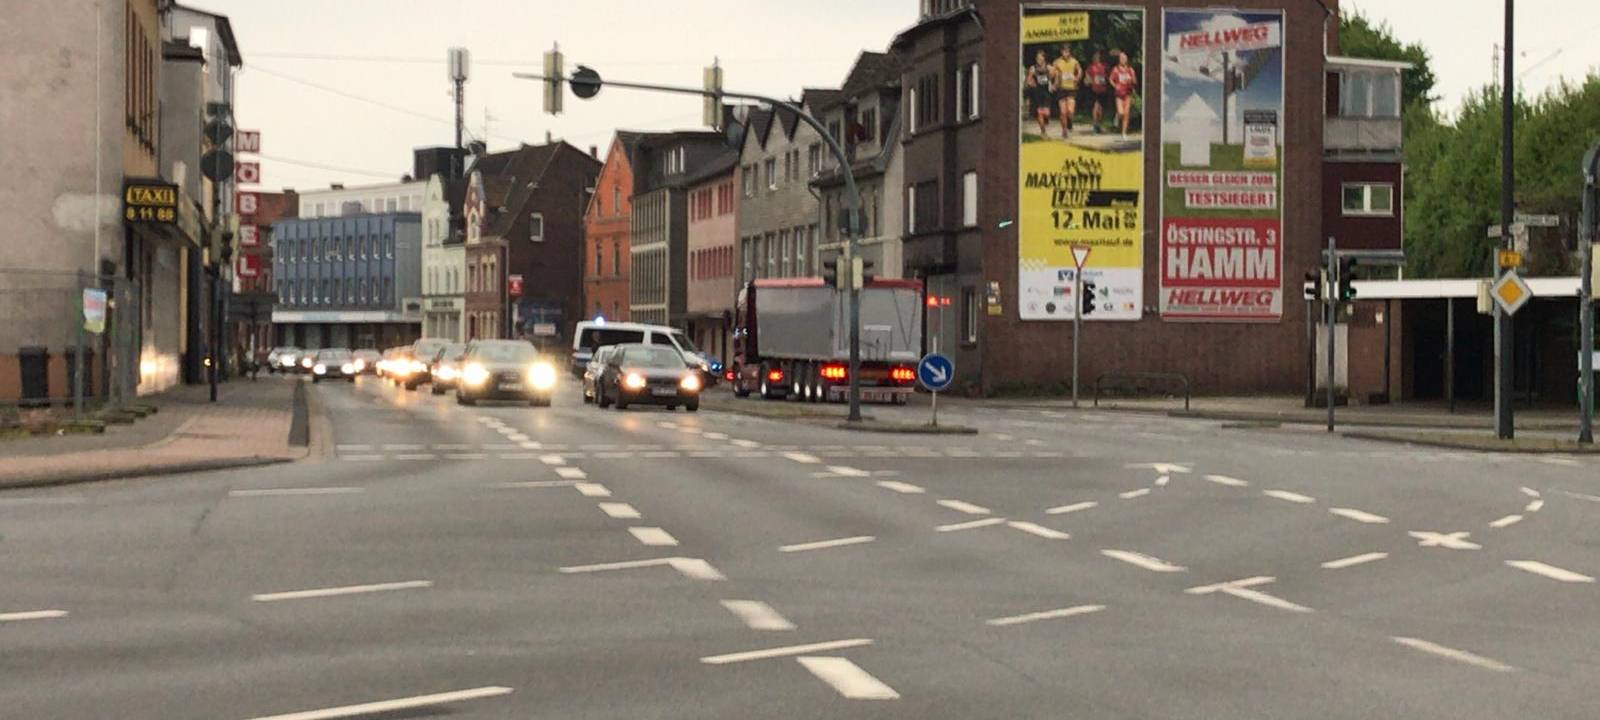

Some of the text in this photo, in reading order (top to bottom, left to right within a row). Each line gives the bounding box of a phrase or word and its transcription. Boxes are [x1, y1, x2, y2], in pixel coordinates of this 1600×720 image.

[1180, 24, 1269, 48] HELLWEG
[1169, 174, 1273, 186] BESSER GLEICH ZUM
[134, 188, 168, 202] TAXI
[1051, 210, 1079, 229] 12.
[1083, 210, 1120, 230] Mai
[1167, 223, 1276, 246] ÖSTINGSTR. 3
[1167, 247, 1276, 280] HAMM
[1168, 288, 1273, 306] HELLWEG
